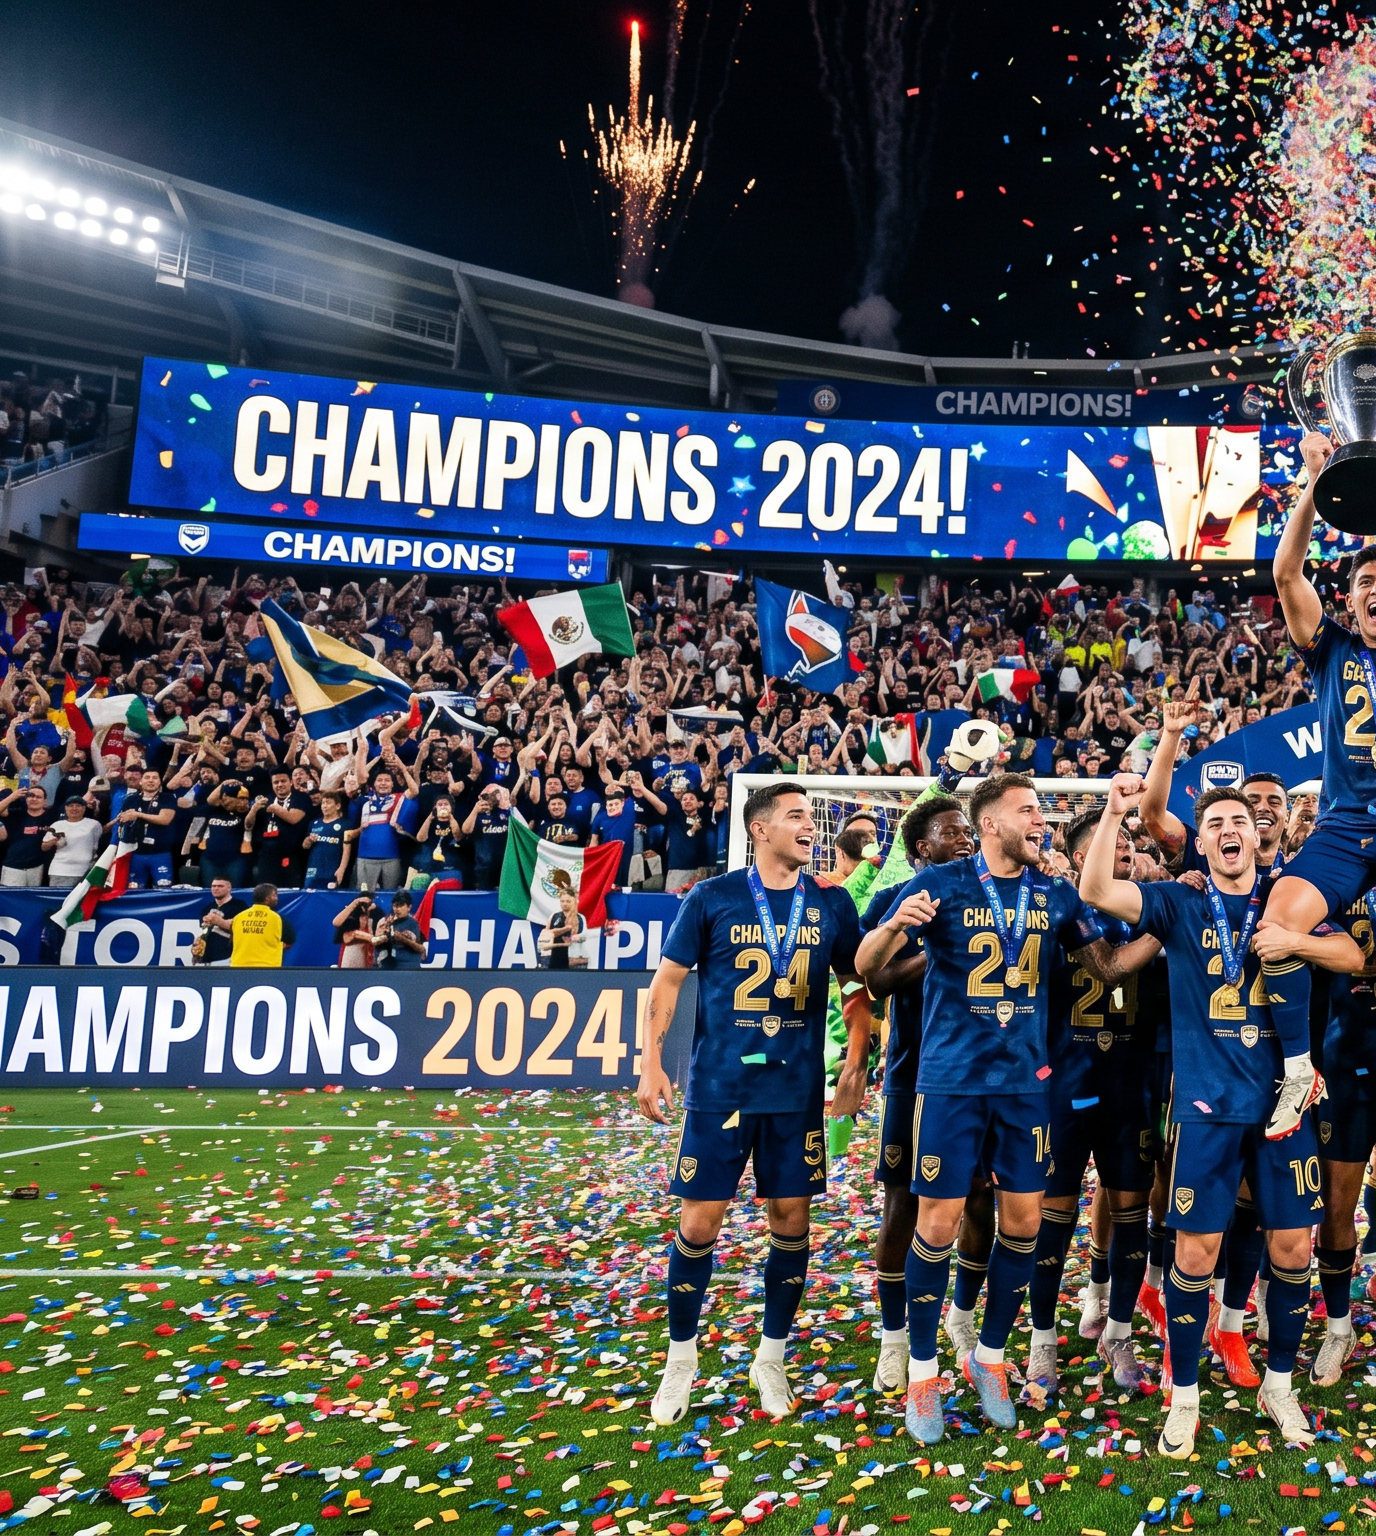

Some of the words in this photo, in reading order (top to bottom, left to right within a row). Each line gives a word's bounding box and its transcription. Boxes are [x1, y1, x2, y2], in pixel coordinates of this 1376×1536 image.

[935, 391, 1132, 417] CHAMPIONS!
[233, 394, 719, 525] CHAMPIONS
[758, 439, 968, 535] 2024!
[263, 530, 516, 573] CHAMPIONS!
[733, 947, 811, 1012] 24
[967, 931, 1042, 997] 24
[0, 985, 402, 1076] AMPIONS
[804, 1129, 824, 1166] 5
[1289, 1155, 1322, 1196] 10
